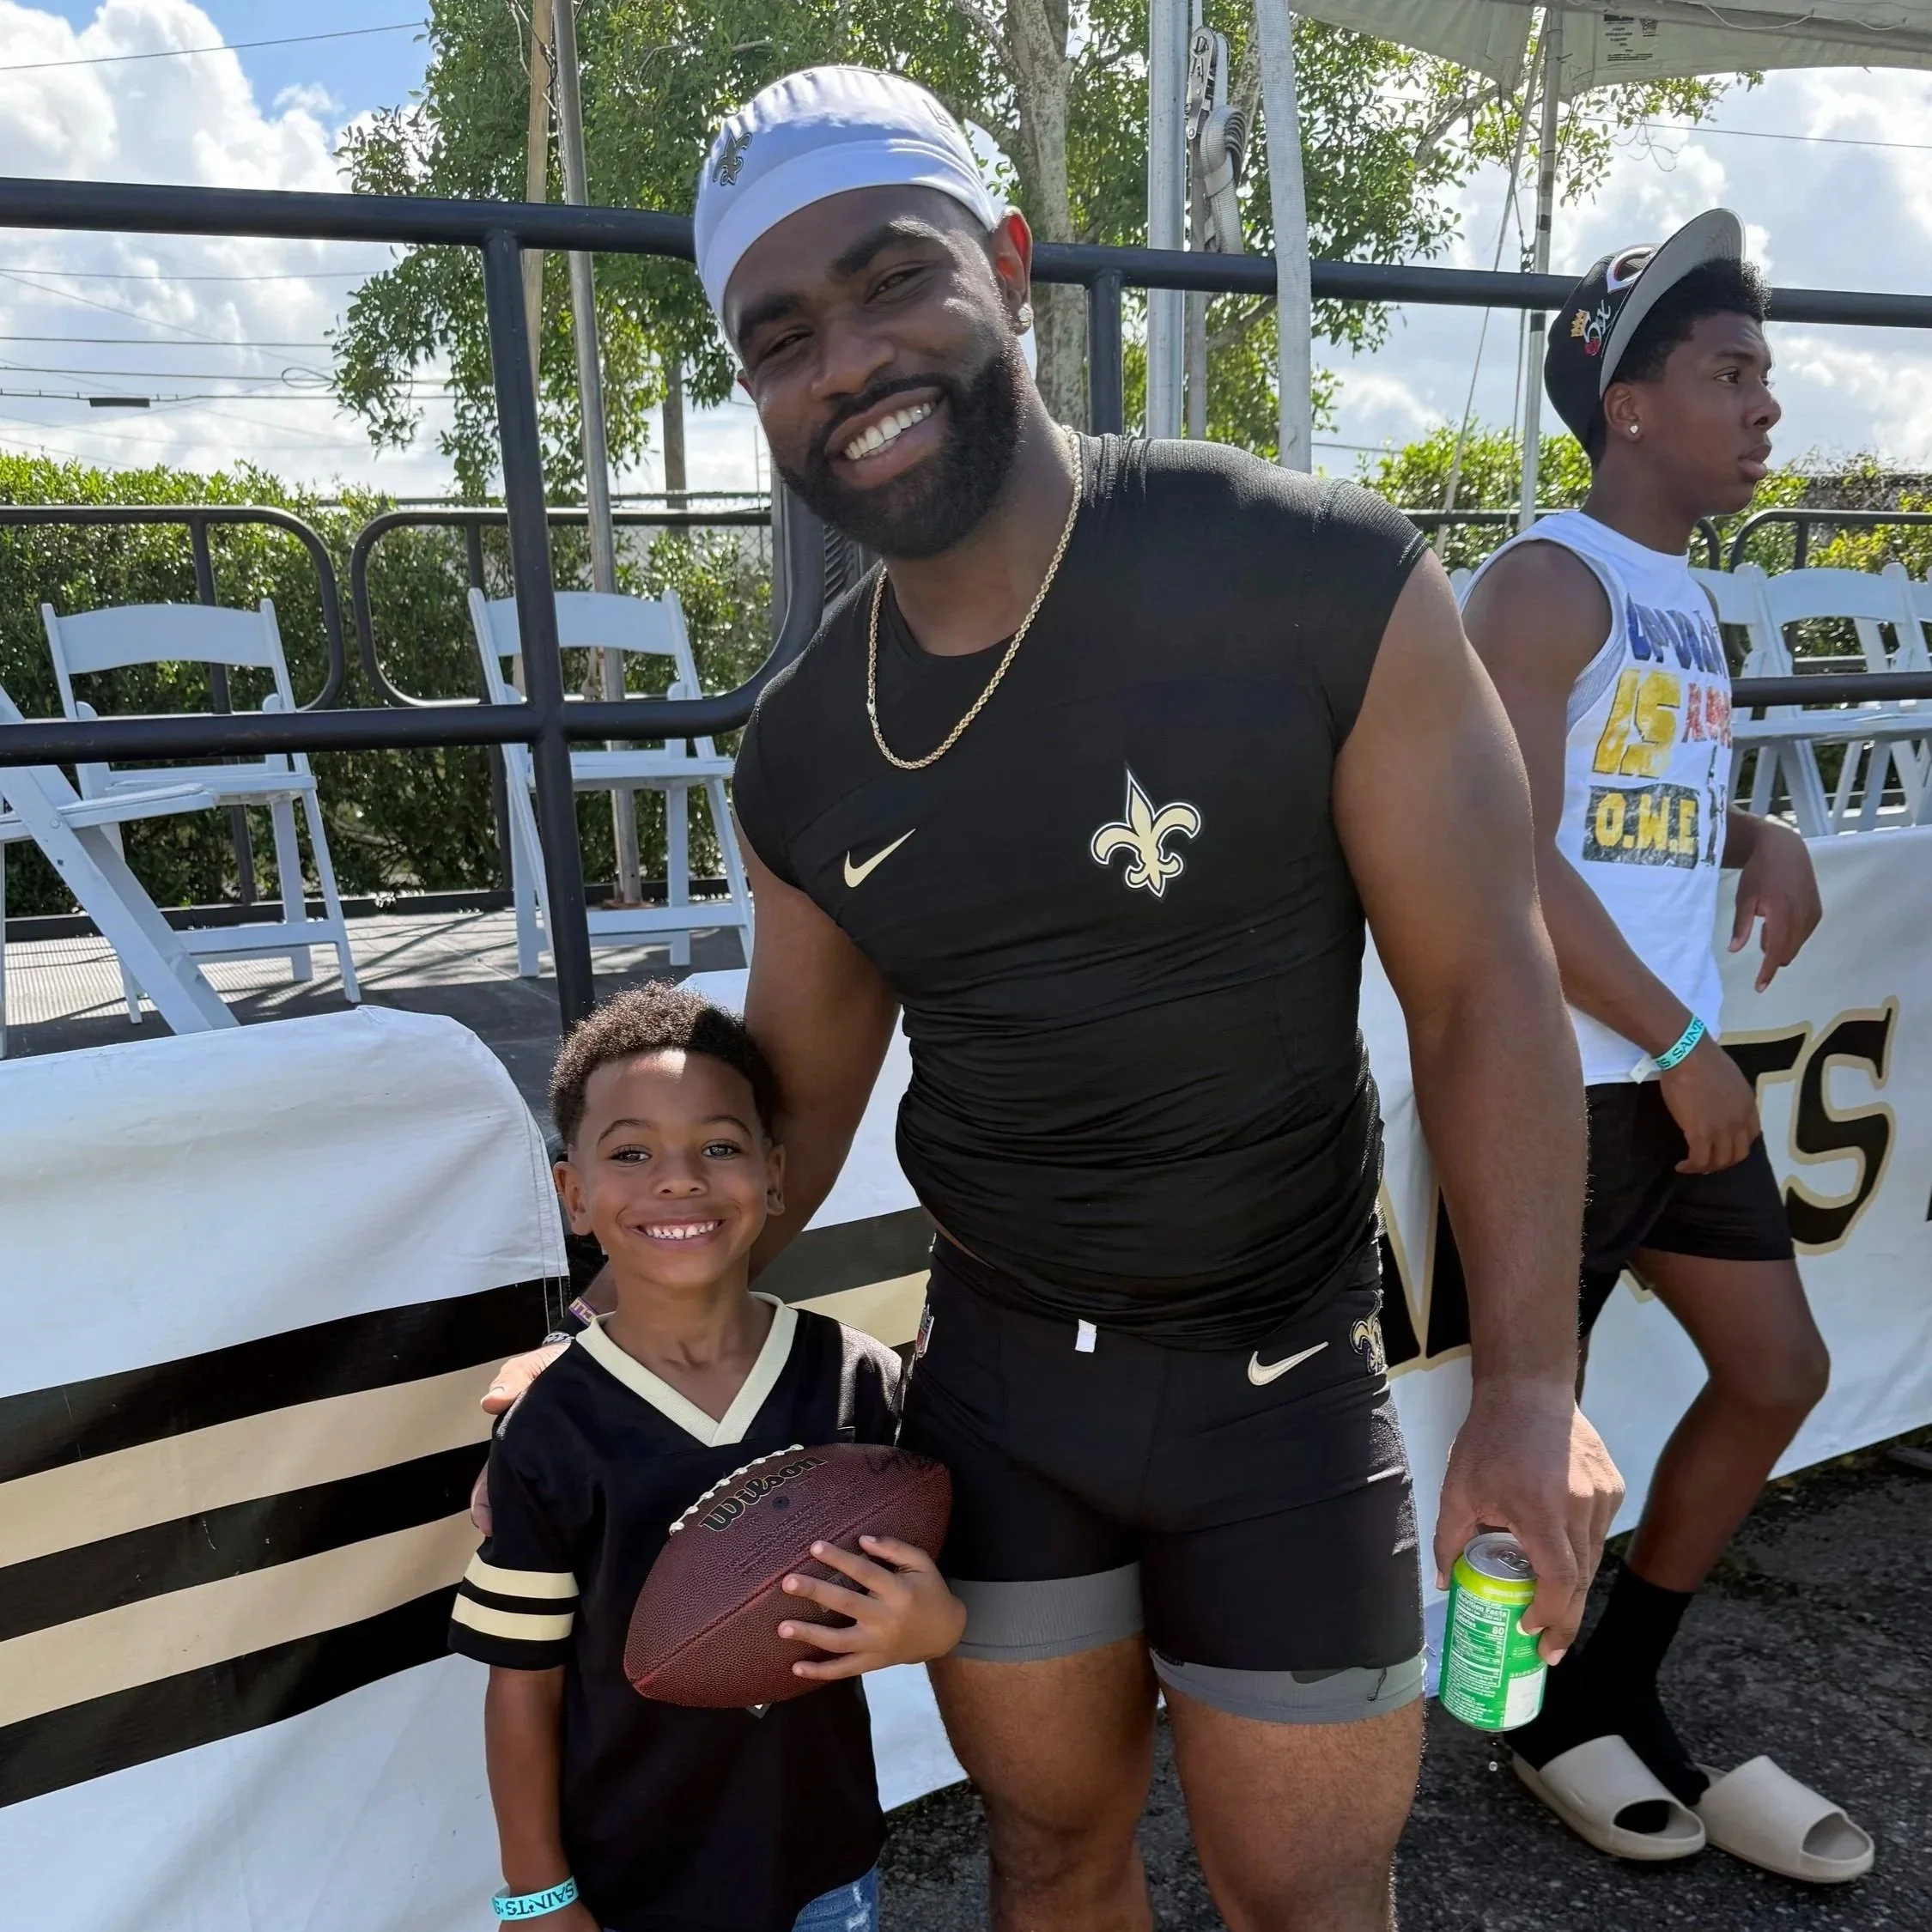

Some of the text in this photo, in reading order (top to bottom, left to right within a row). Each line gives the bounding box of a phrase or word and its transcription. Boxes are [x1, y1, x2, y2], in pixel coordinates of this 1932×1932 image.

[698, 1456, 828, 1532] Wilson
[1492, 1625, 1504, 1635] 80
[505, 1882, 574, 1916] SAINTS
